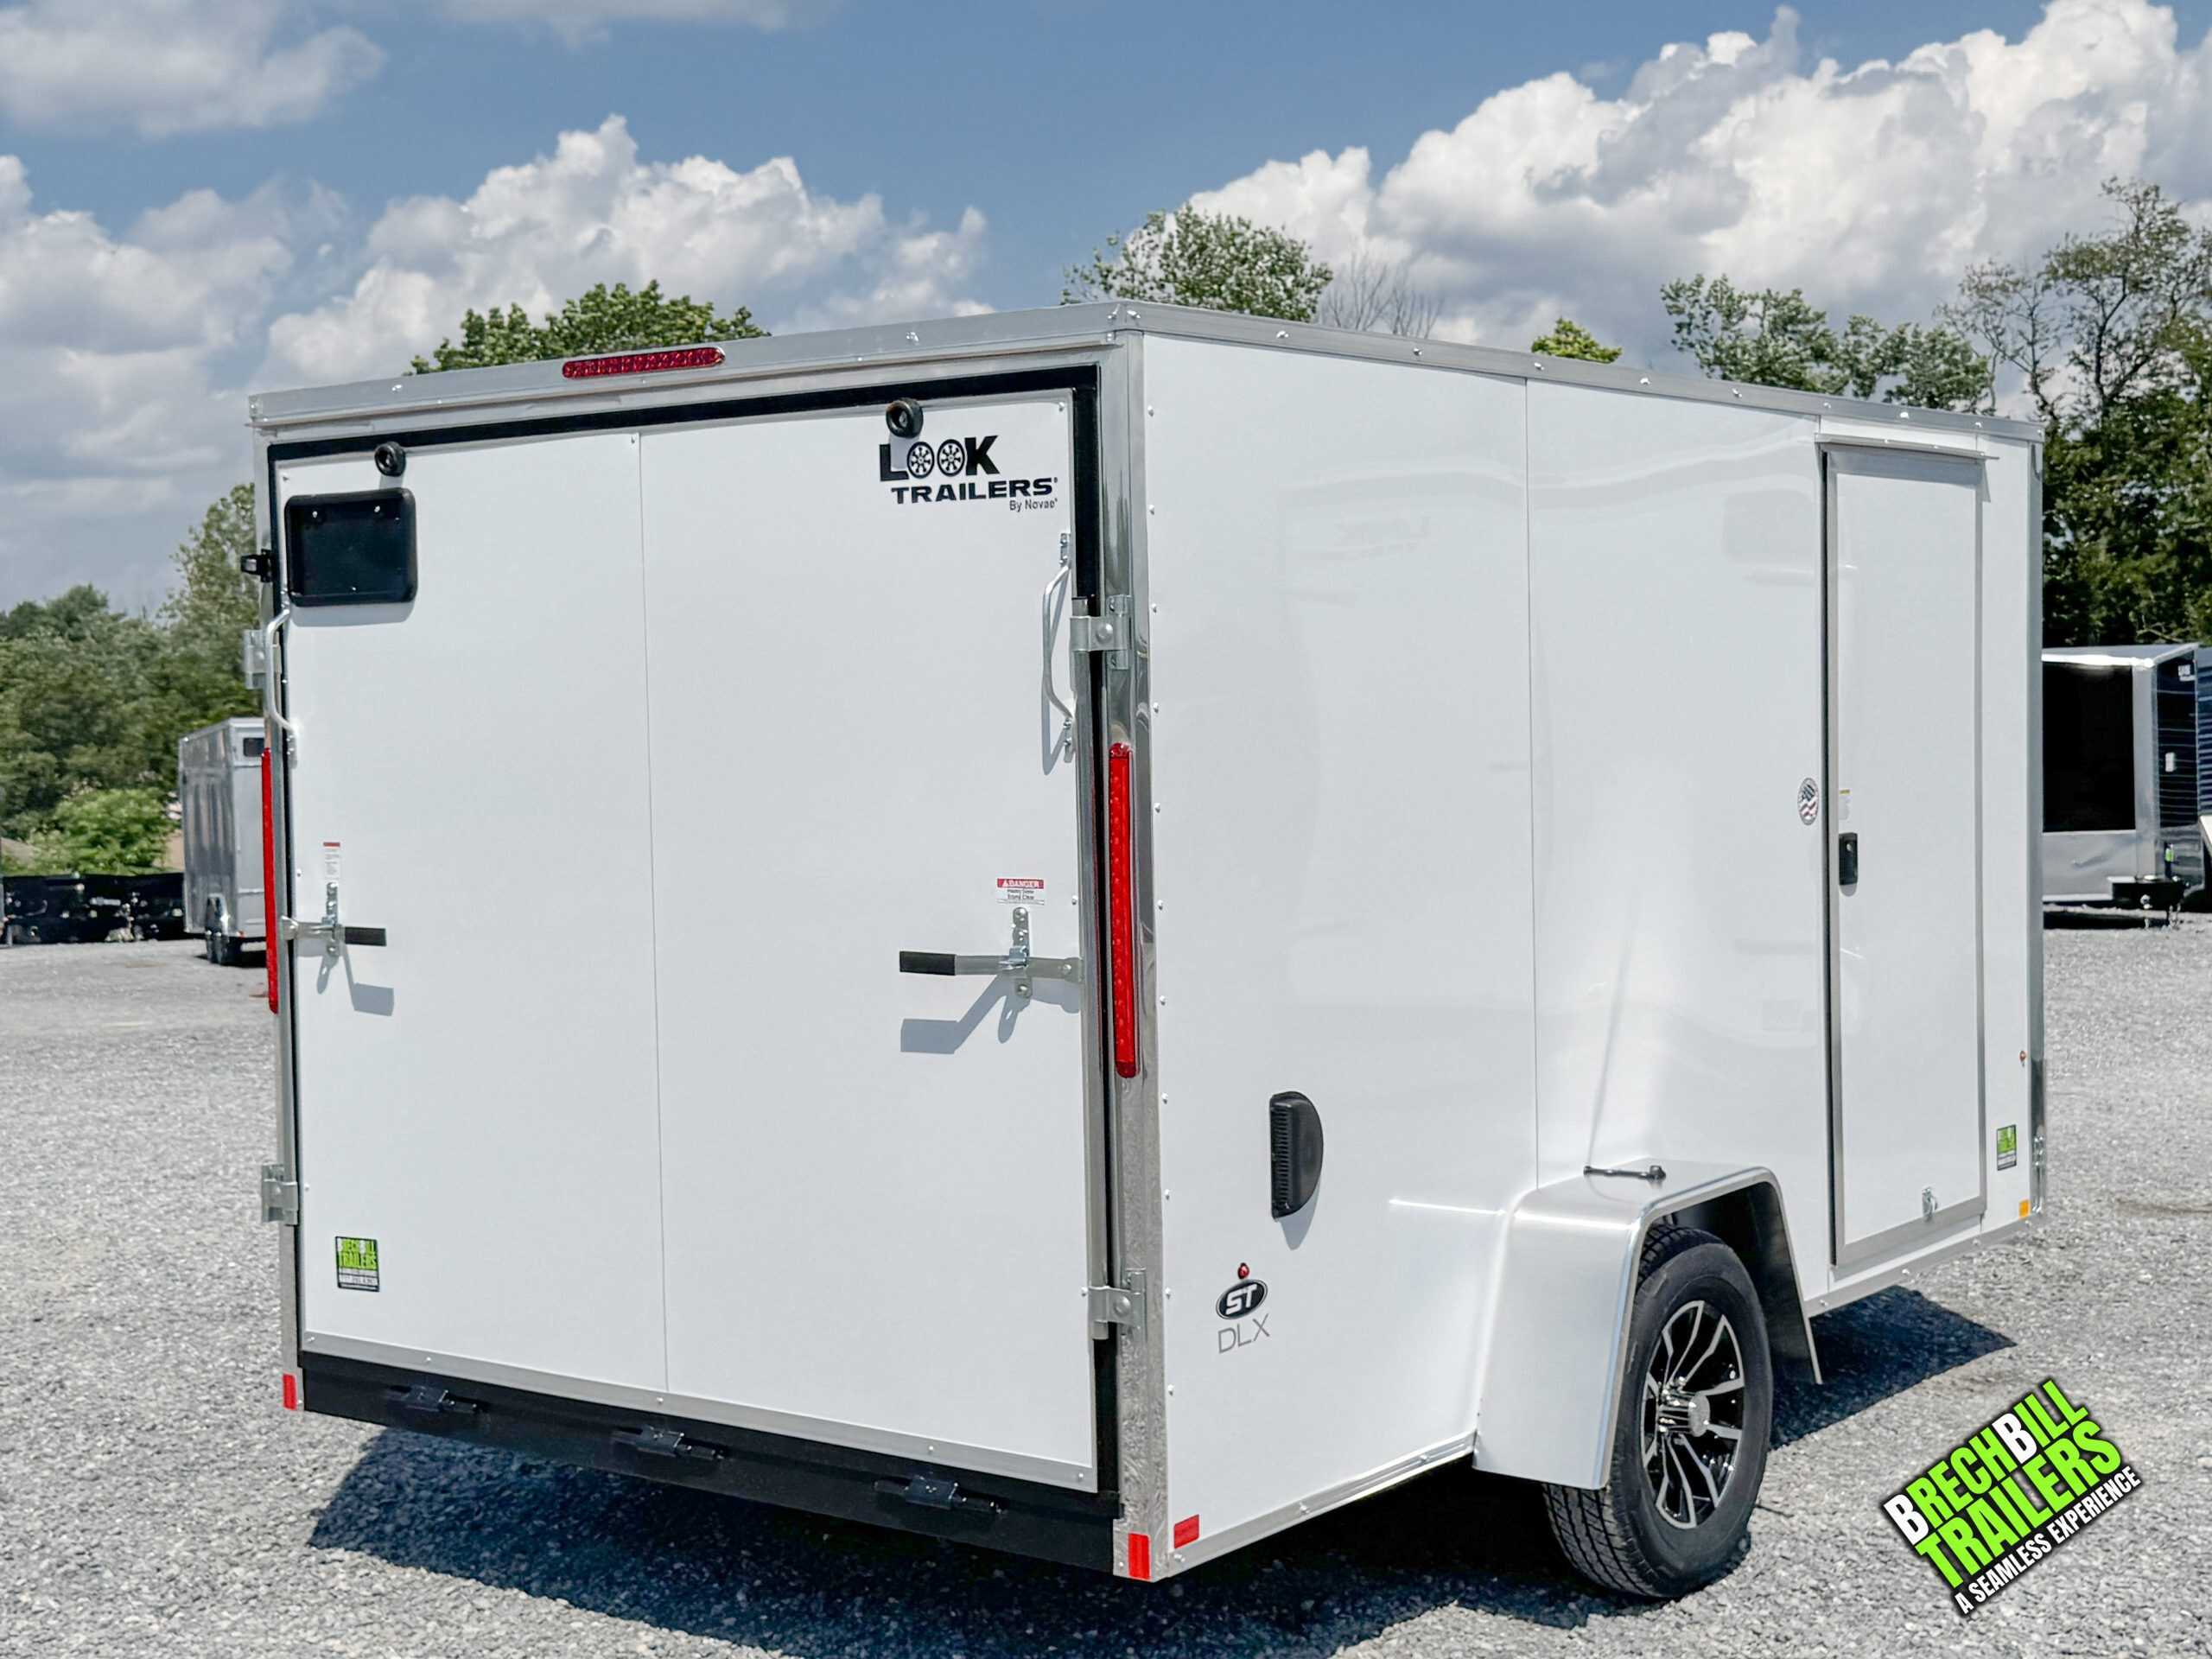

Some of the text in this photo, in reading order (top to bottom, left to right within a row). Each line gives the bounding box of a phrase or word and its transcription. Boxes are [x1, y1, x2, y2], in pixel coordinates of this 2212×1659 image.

[880, 435, 1000, 481] LOOK
[1009, 499, 1022, 512] By
[1225, 1283, 1257, 1315] ST
[1217, 1313, 1270, 1354] DLX
